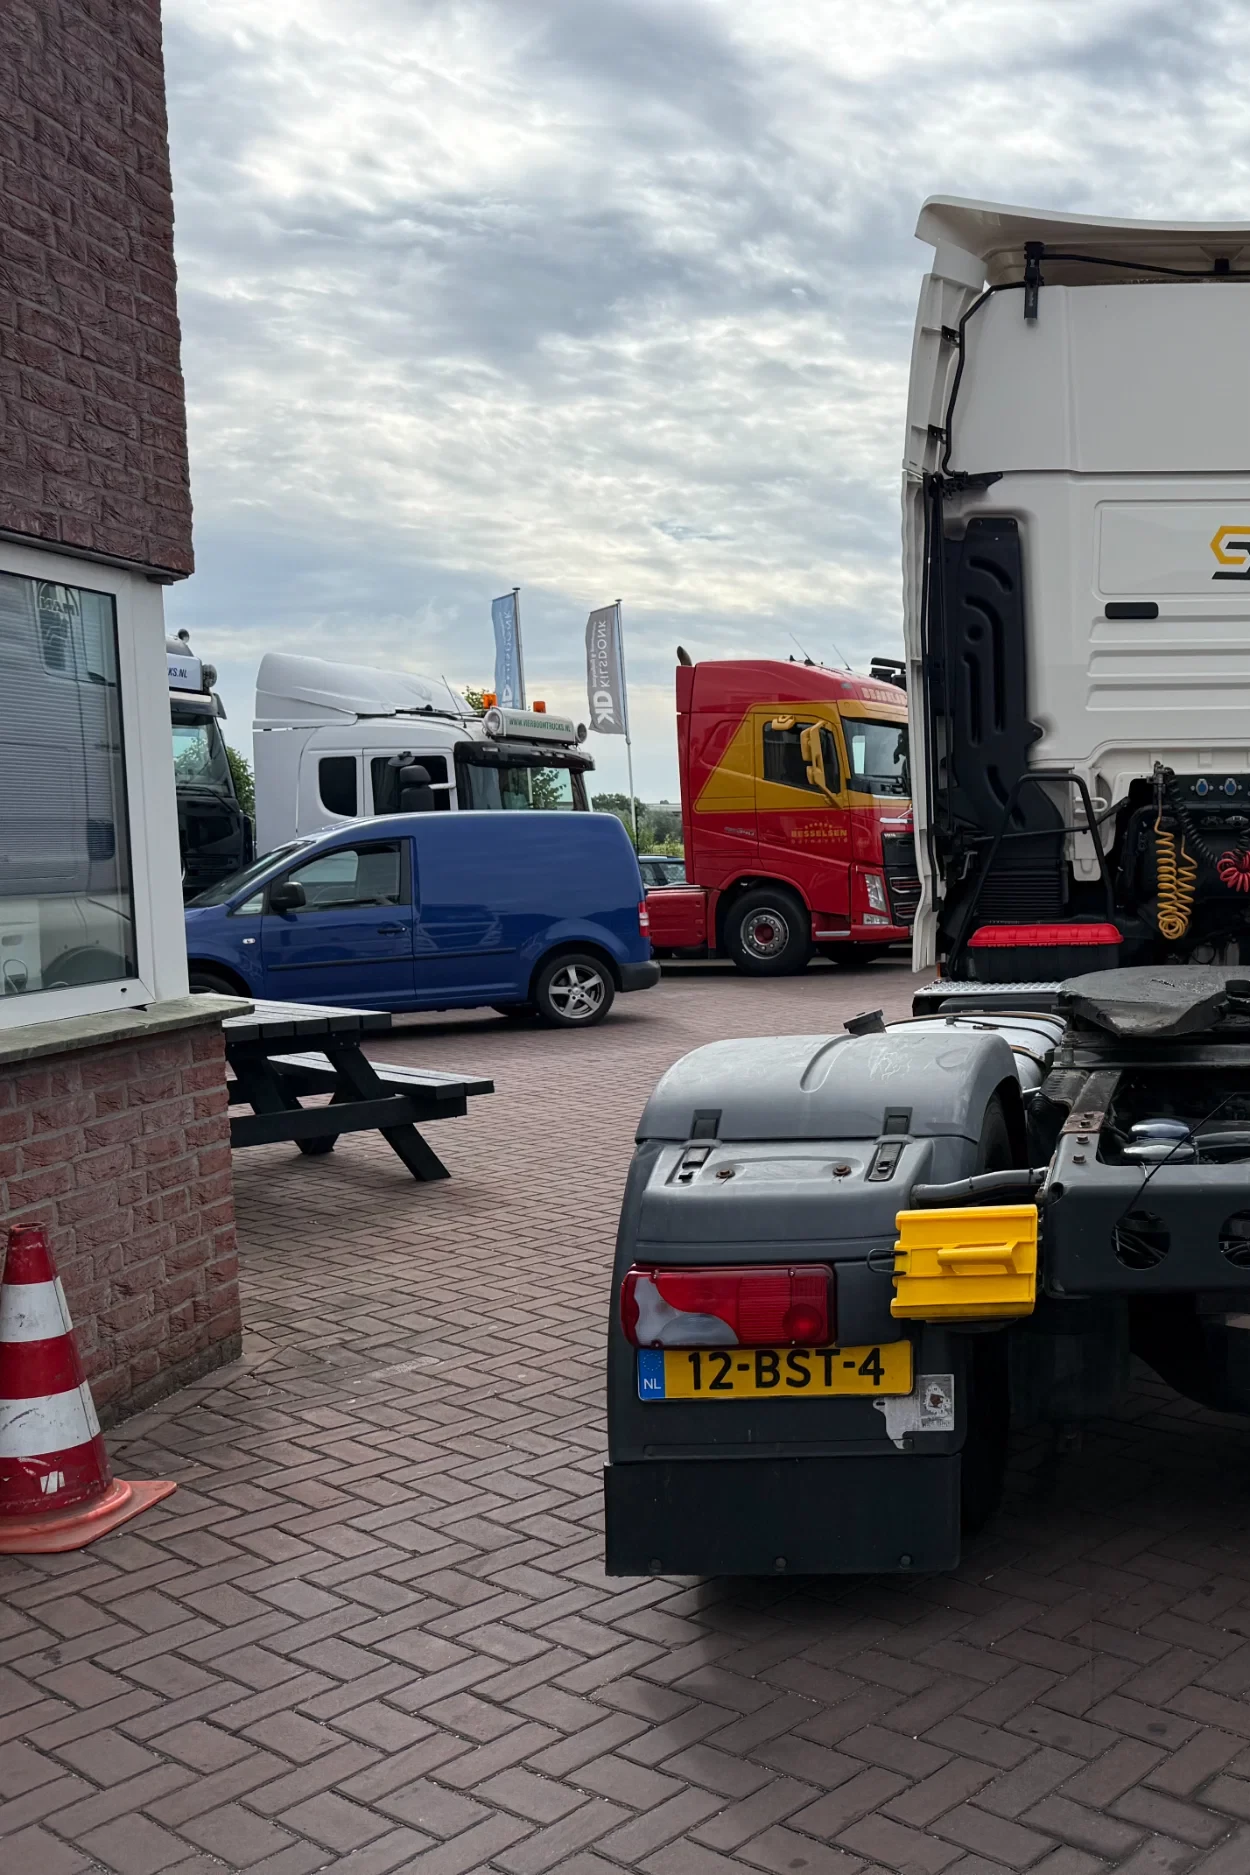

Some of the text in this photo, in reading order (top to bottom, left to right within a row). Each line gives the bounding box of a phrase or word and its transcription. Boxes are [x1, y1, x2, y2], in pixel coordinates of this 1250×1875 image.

[791, 829, 848, 838] BESSELSEN
[643, 1347, 885, 1391] NL 12-BST-4
